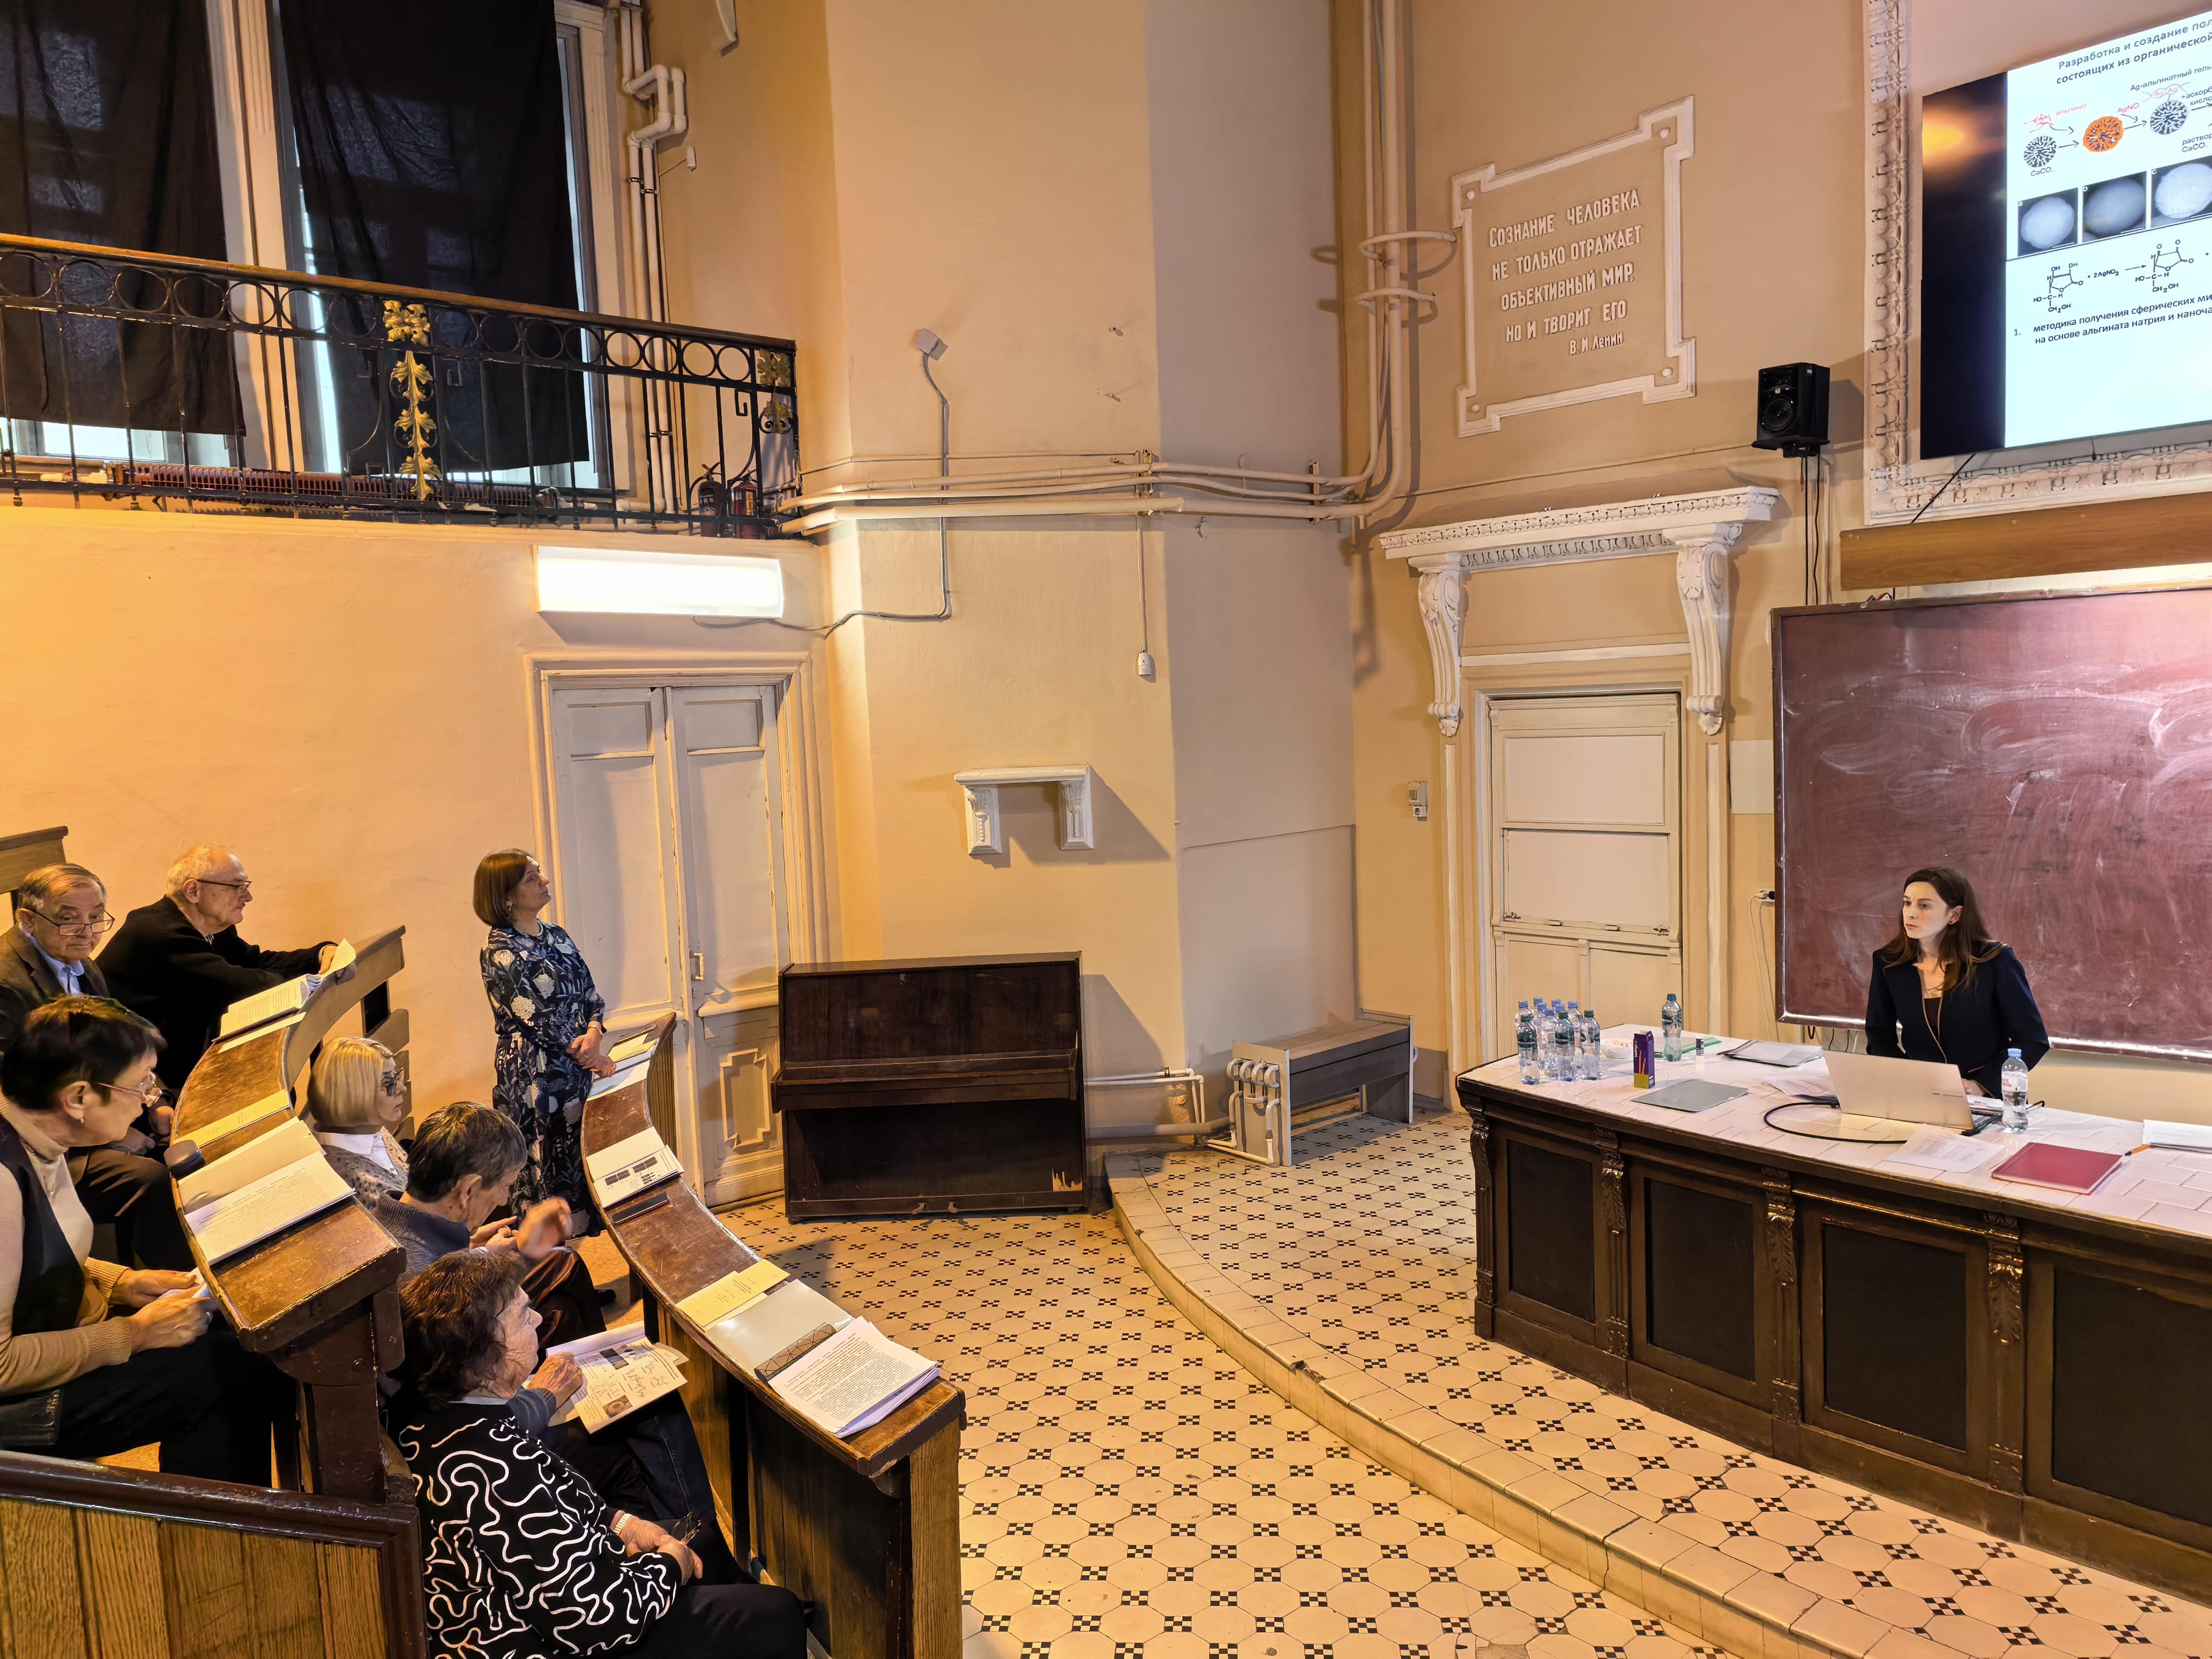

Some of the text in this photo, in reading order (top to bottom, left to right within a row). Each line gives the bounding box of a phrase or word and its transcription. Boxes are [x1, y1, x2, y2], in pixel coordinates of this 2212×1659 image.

[2059, 46, 2120, 69] Разработка
[2124, 43, 2130, 51] и
[2134, 26, 2189, 47] создание
[2056, 62, 2114, 84] состоящих
[2117, 58, 2130, 66] из
[2055, 103, 2087, 116] альгинат
[1489, 189, 1640, 248] СОЗНАНИЕ ЧЕЛОВЕКА
[1492, 224, 1642, 281] НЕ ТОЛЬКО ОТРАЖАЕТ
[1501, 269, 1596, 312] ОБЪЕКТИВНЫЙ
[1506, 325, 1522, 343] НО
[1527, 320, 1537, 340] И
[1602, 300, 1627, 322] ЕГО
[2013, 328, 2021, 336] 1.
[2033, 319, 2076, 333] методика
[2079, 309, 2129, 325] получения
[2131, 297, 2195, 315] сферических
[2048, 331, 2080, 342] основе
[2082, 322, 2129, 336] альгината
[2132, 316, 2165, 327] натрия
